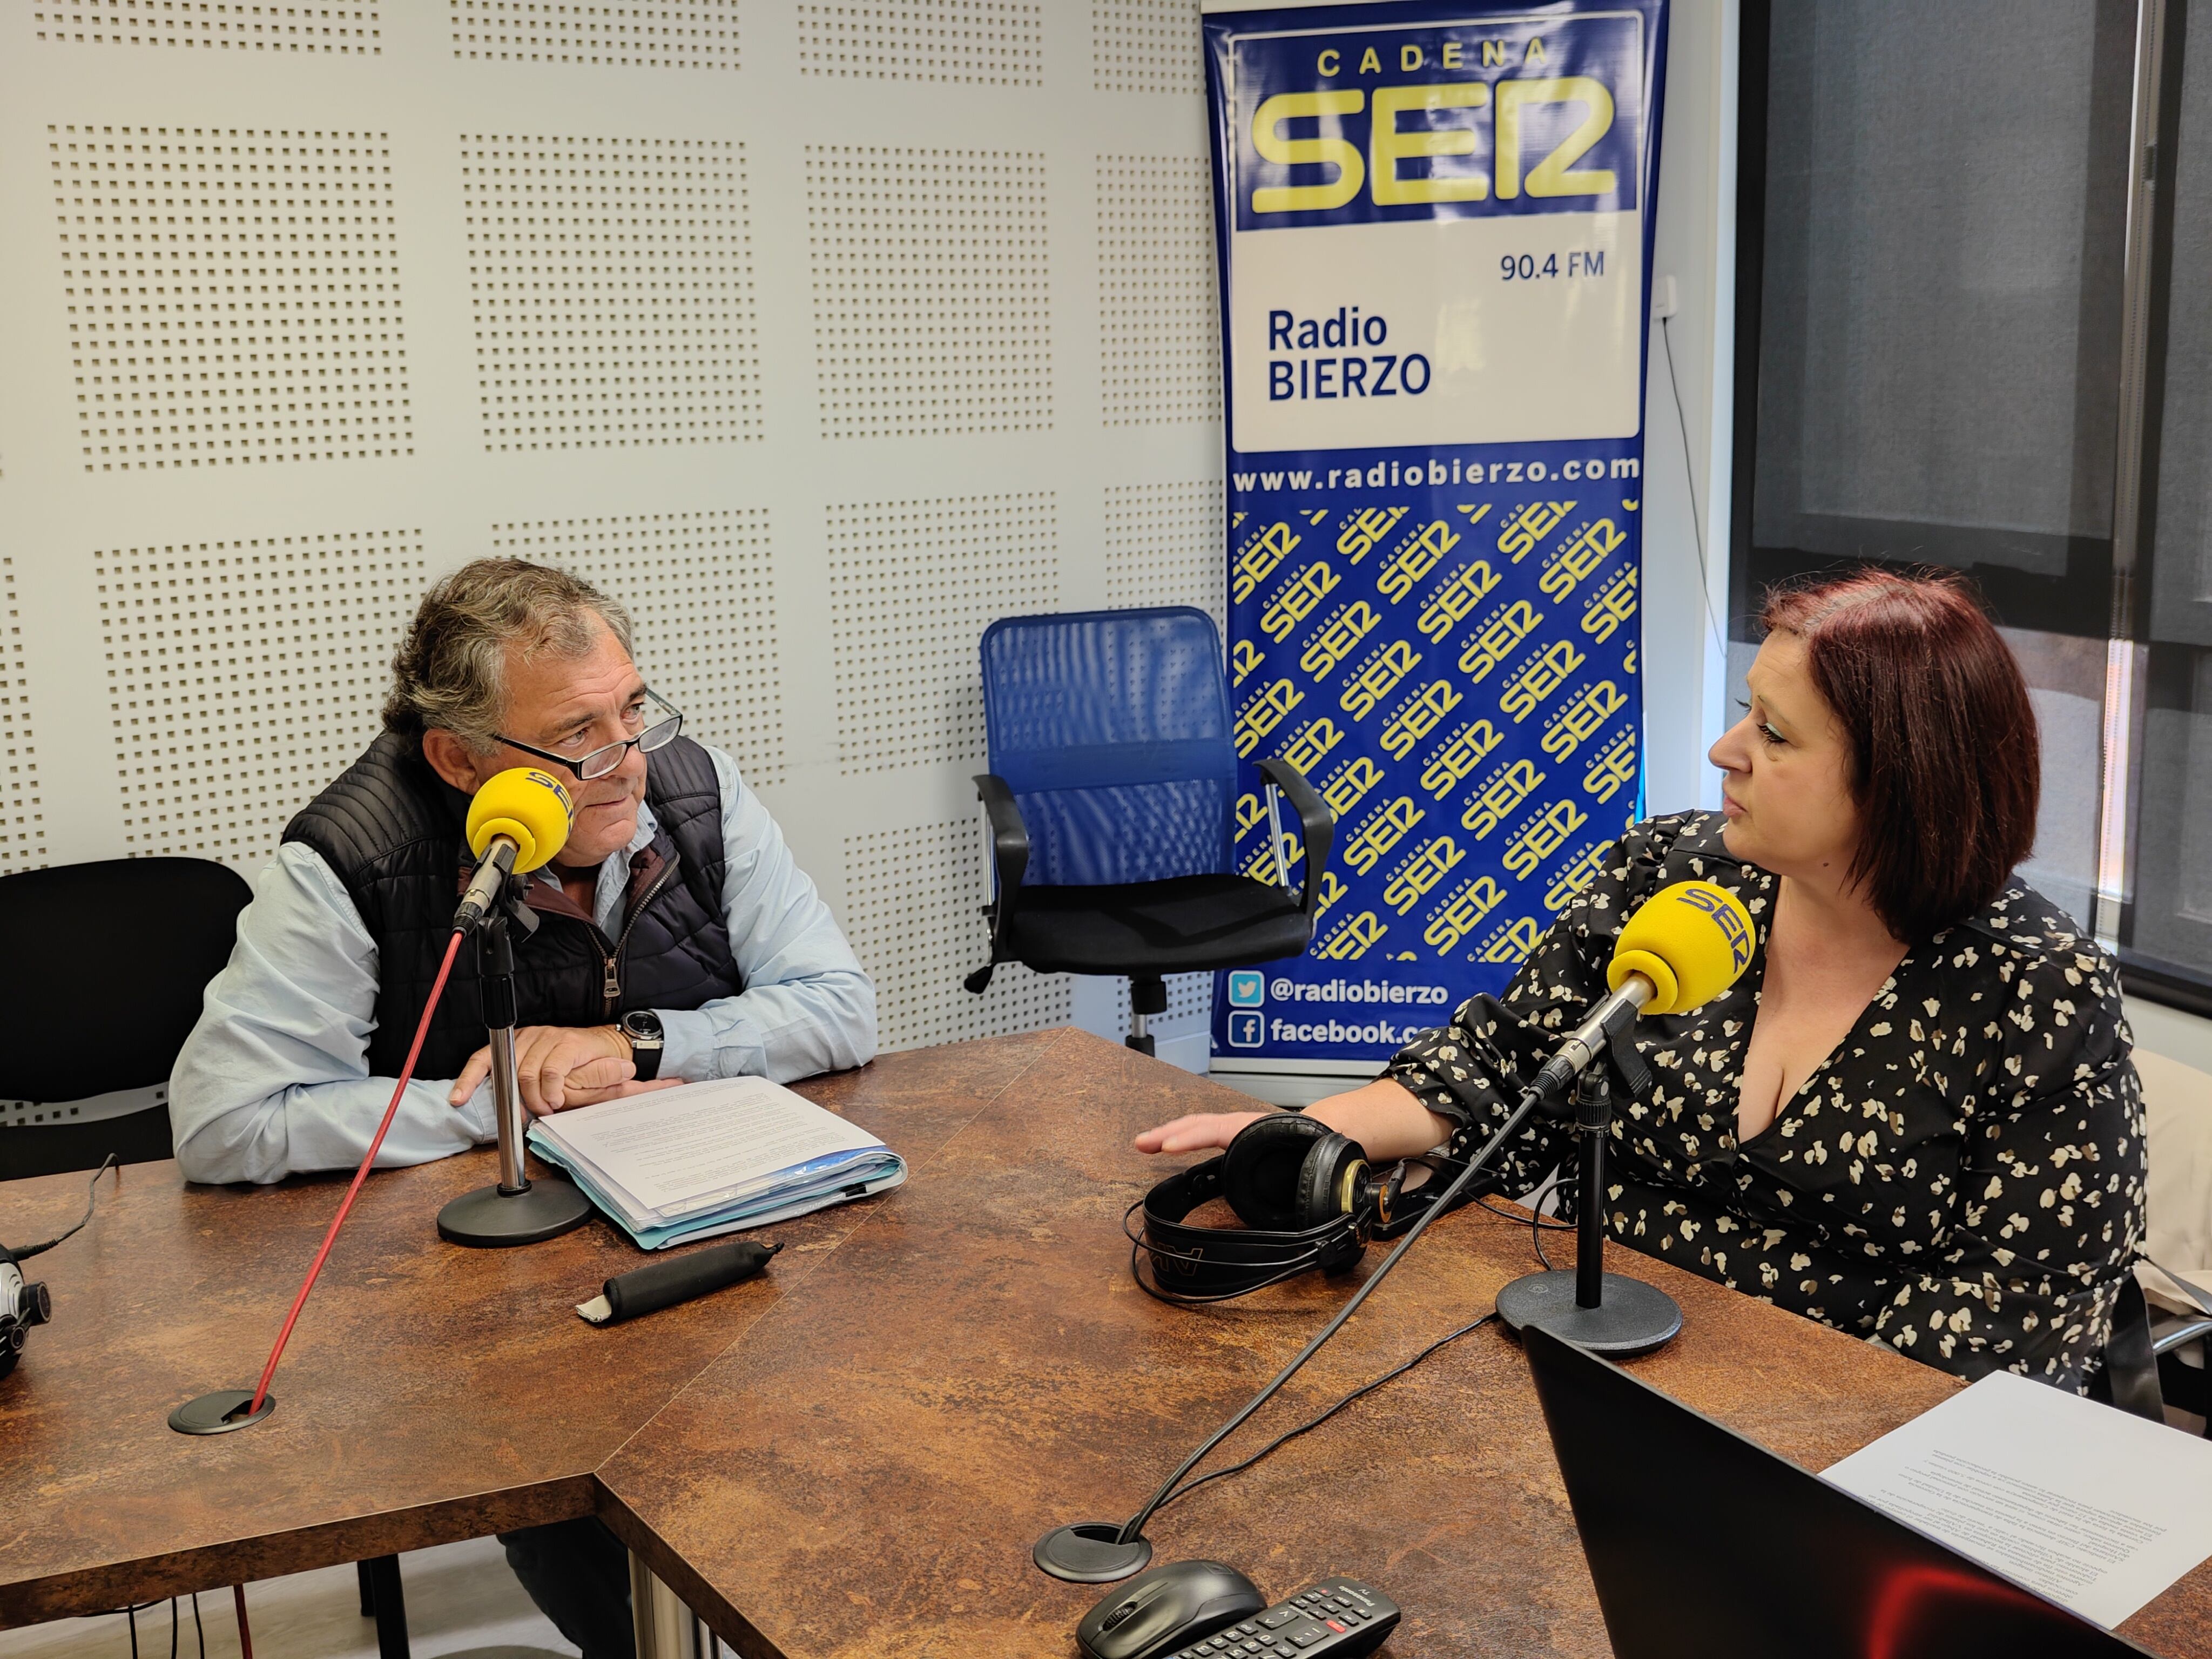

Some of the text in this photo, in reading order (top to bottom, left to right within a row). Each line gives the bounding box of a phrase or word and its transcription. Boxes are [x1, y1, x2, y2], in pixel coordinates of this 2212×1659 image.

[1317, 37, 1546, 77] CADENA
[1251, 76, 1616, 213] SER
[1501, 251, 1604, 280] 90.4 FM
[1269, 307, 1387, 350] Radio
[1269, 353, 1431, 401] BIERZO
[1233, 455, 1640, 492] www.radiobierzo.com
[1377, 520, 1461, 605] SER
[1379, 523, 1425, 570] CADENA
[1539, 518, 1627, 604] SER
[1541, 521, 1590, 568] CADENA
[1260, 561, 1341, 644] SER
[1263, 564, 1307, 609] CADENA
[1417, 559, 1502, 644] SER
[1420, 563, 1467, 610] CADENA
[1583, 562, 1632, 608] CADENA
[1300, 601, 1381, 683] SER
[1303, 603, 1347, 648] CADENA
[1458, 599, 1544, 684] SER
[1461, 603, 1508, 649] CADENA
[1340, 640, 1422, 722] SER
[1342, 643, 1387, 687] CADENA
[1499, 640, 1586, 724] SER
[1502, 643, 1549, 689] CADENA
[1380, 679, 1464, 761] SER
[1382, 682, 1428, 726] CADENA
[1541, 680, 1628, 764] SER
[1543, 683, 1591, 728] CADENA
[1419, 719, 1505, 801] SER
[1422, 721, 1468, 766] CADENA
[1586, 723, 1634, 768] CADENA
[1464, 761, 1510, 806] CADENA
[1583, 731, 1635, 804] SE
[1346, 798, 1390, 841] CADENA
[1461, 759, 1546, 841] SER
[1343, 796, 1425, 876] SER
[1502, 799, 1588, 881] SER
[1505, 801, 1552, 846] CADENA
[1383, 835, 1466, 916] SER
[1386, 838, 1431, 882] CADENA
[1547, 842, 1594, 886] CADENA
[1424, 876, 1508, 957] SER
[1426, 878, 1472, 922] CADENA
[1310, 913, 1354, 956] CADENA
[1467, 919, 1513, 962] CADENA
[1676, 888, 1750, 974] SER
[1270, 977, 1448, 1006] @radiobierzo
[1271, 1017, 1432, 1044] facebook.c
[1337, 1584, 1375, 1607] Panasonic
[1357, 1587, 1372, 1596] TV
